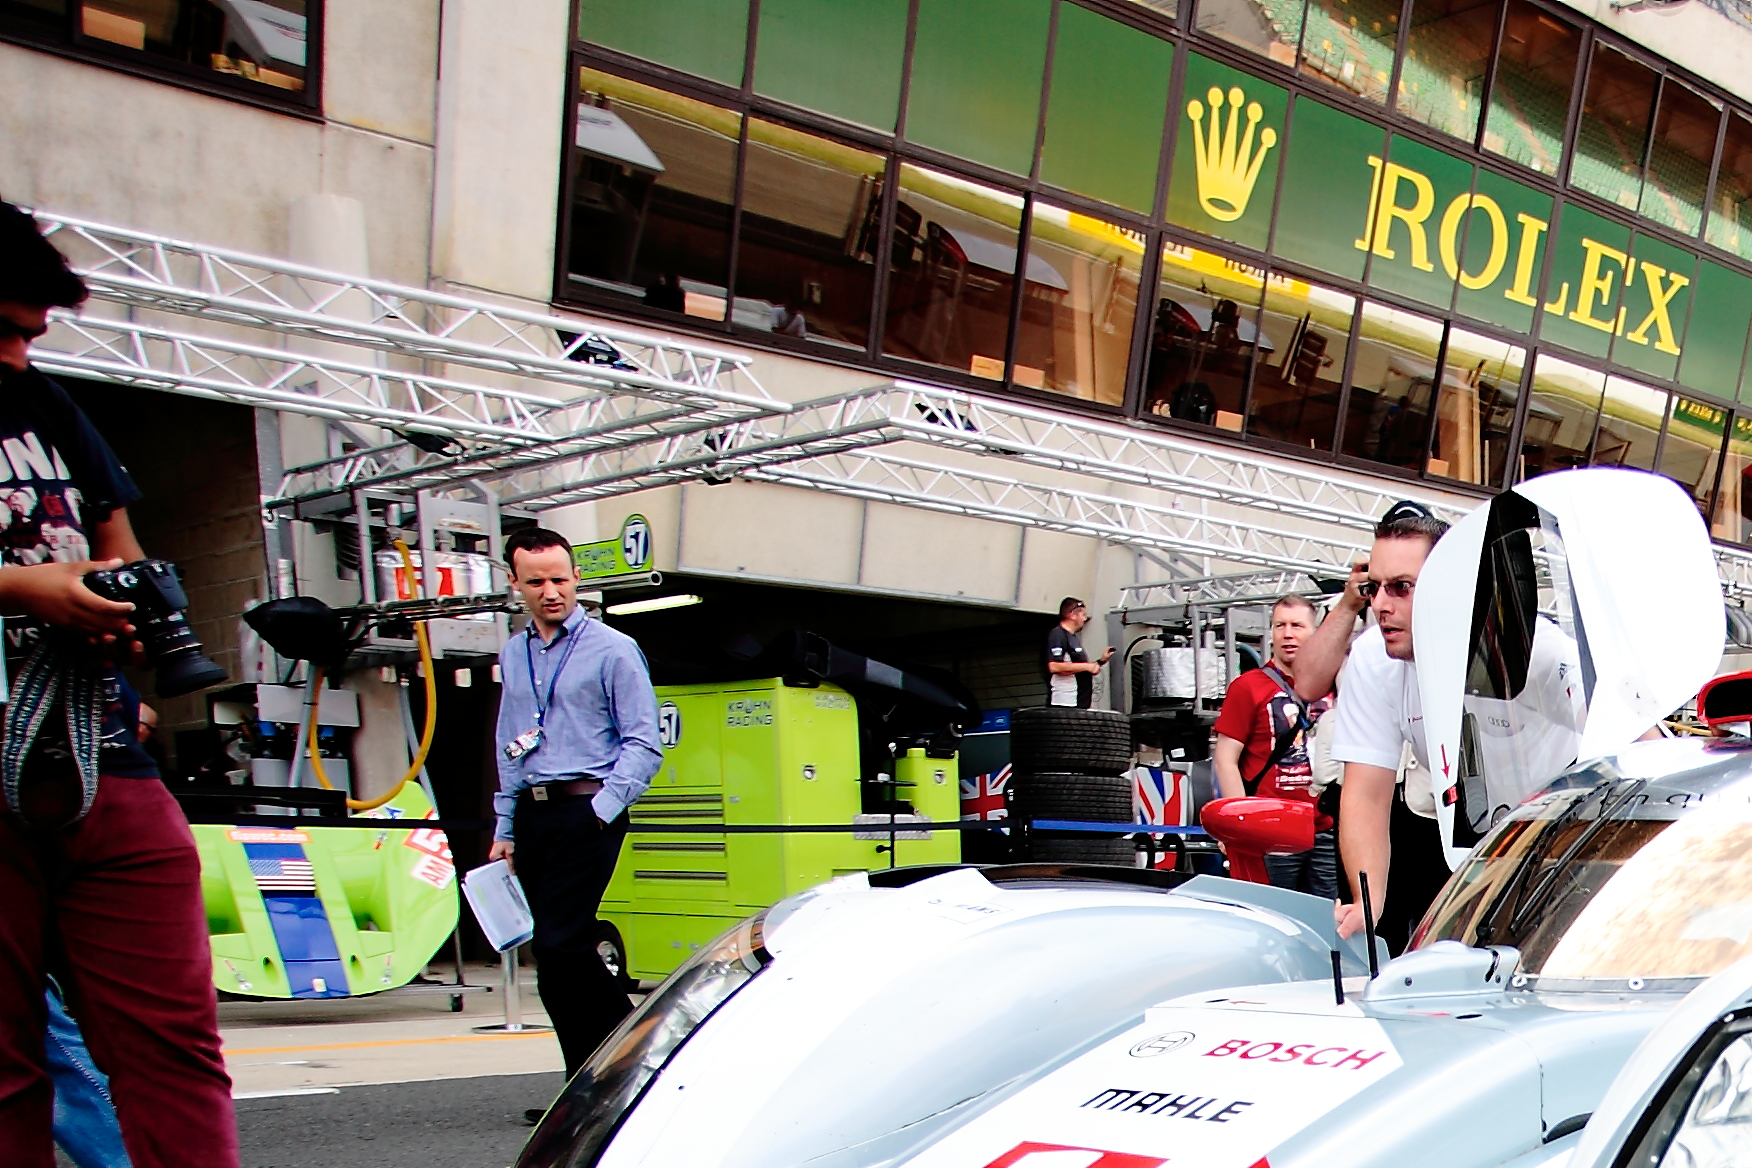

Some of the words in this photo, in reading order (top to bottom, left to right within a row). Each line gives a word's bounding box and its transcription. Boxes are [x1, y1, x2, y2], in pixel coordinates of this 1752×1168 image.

[1355, 155, 1689, 355] ROLEX
[624, 523, 646, 566] 57
[659, 705, 678, 745] 57
[727, 714, 773, 728] RACING
[1201, 1039, 1387, 1071] BOSCH
[1078, 1087, 1256, 1123] MAHLE
